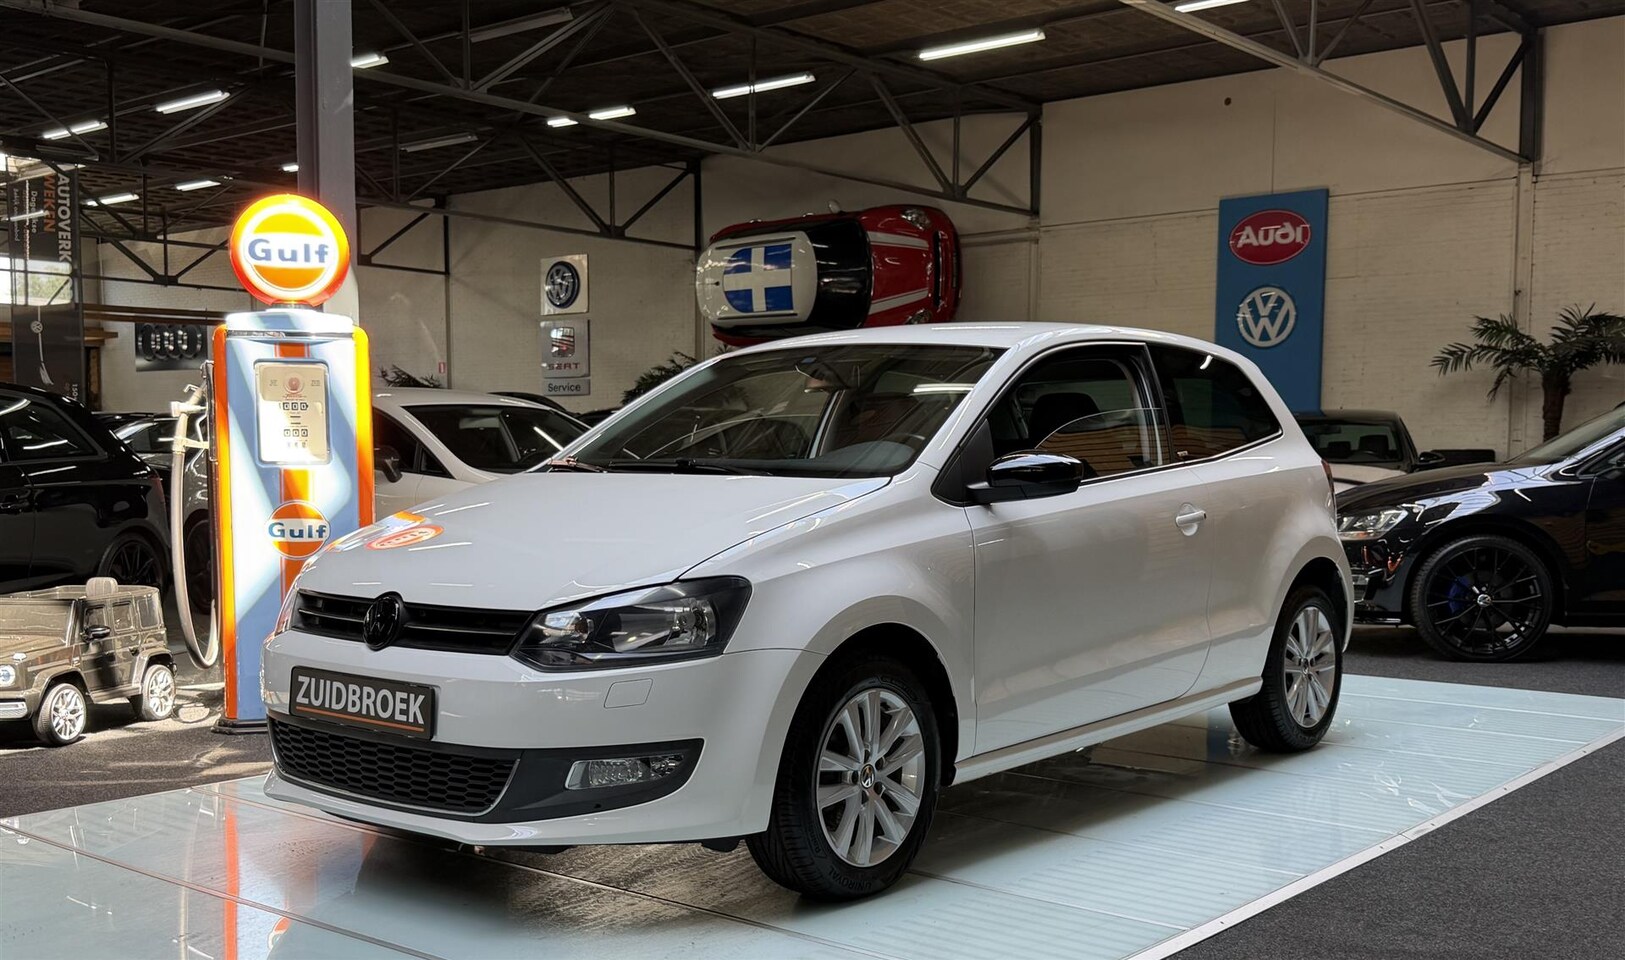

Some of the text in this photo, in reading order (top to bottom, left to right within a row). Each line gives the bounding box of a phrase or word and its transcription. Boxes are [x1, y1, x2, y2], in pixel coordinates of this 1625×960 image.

[43, 174, 56, 232] WEKEN
[1236, 221, 1304, 249] Audi
[247, 238, 330, 264] Gulf
[547, 362, 581, 371] SEAT
[547, 383, 582, 393] Service
[268, 521, 327, 539] Gulf
[295, 675, 425, 725] ZUIDBROEK
